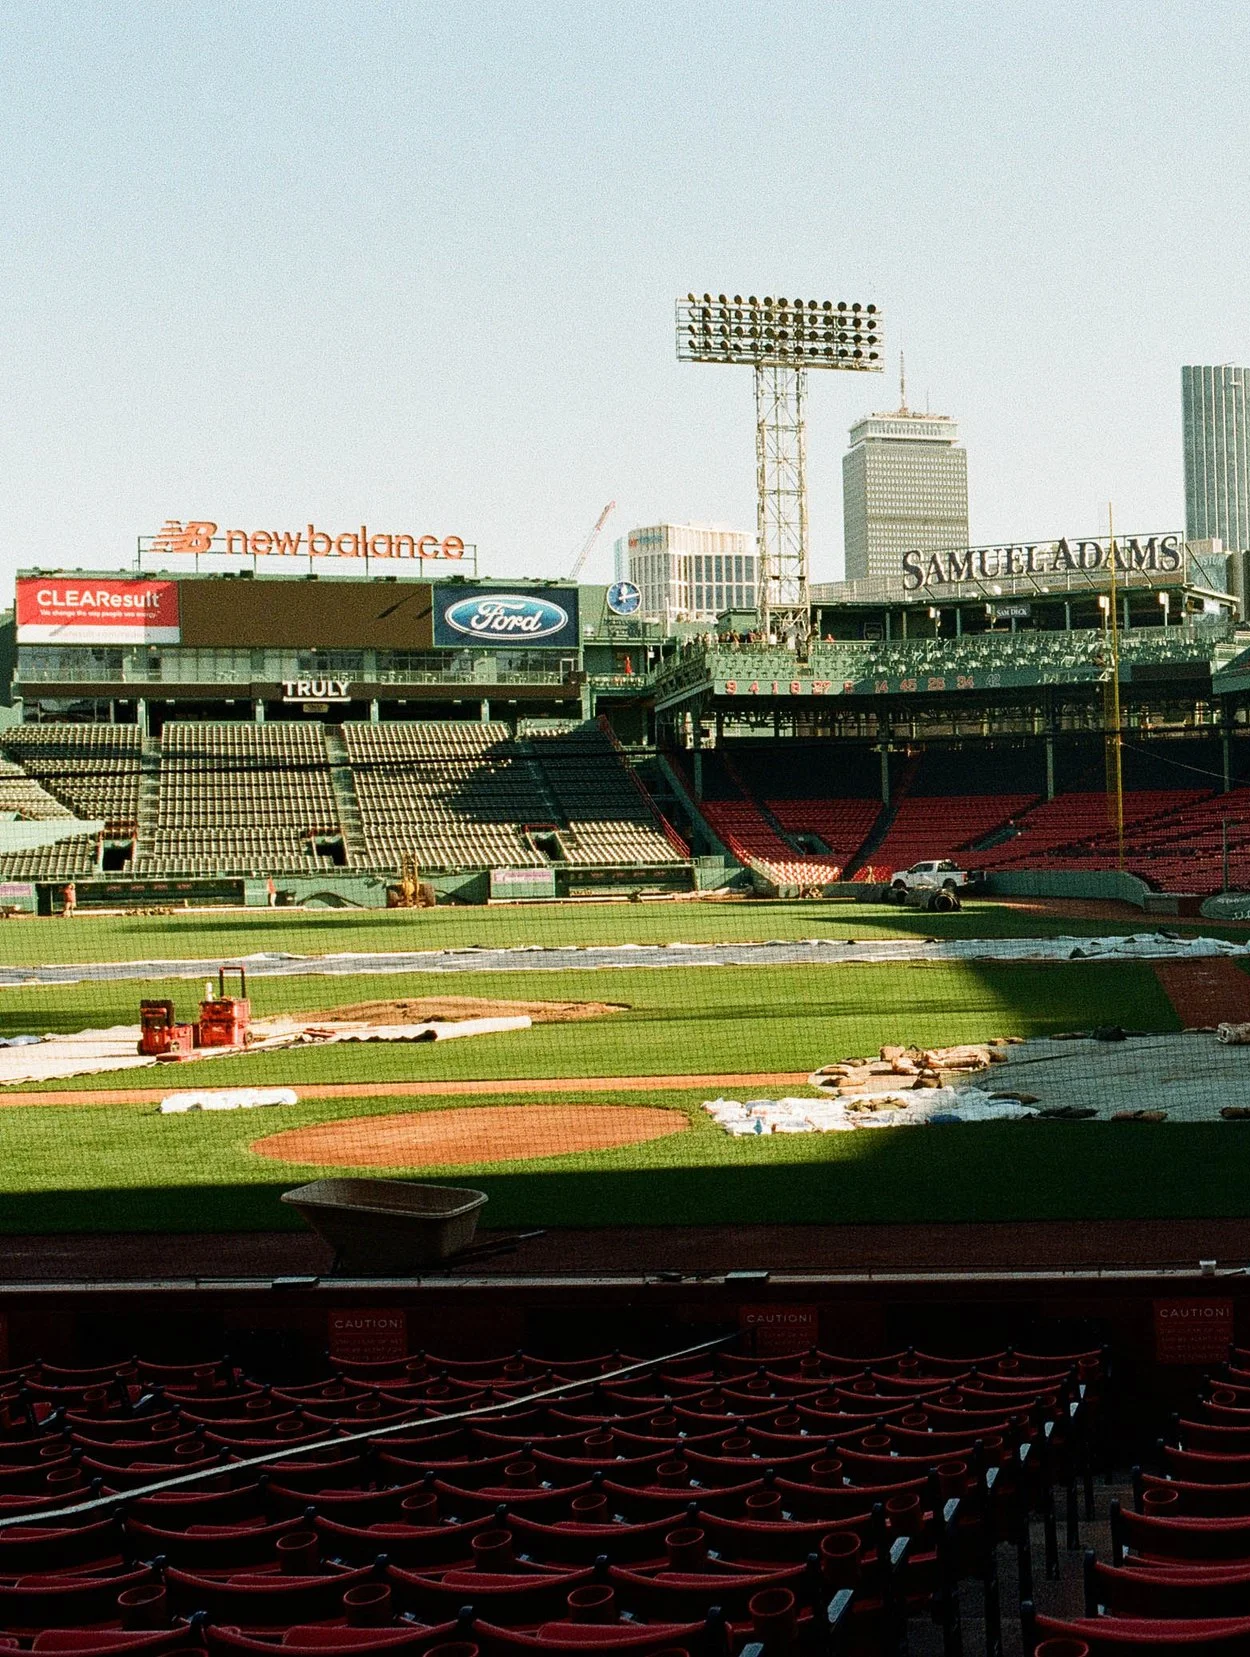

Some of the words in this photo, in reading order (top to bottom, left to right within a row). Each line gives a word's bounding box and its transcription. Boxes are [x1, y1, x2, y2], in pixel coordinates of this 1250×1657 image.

[902, 545, 1045, 590] SAMUEL
[1053, 536, 1181, 572] ADAMS
[37, 589, 160, 608] CLEAResult
[471, 600, 544, 632] Ford
[282, 680, 350, 697] TRULY
[726, 680, 737, 694] 9
[748, 680, 759, 694] 4
[772, 680, 779, 694] 1
[812, 680, 831, 694] 27
[875, 680, 889, 694] 14
[900, 678, 918, 692] 45
[956, 676, 975, 689] 34
[746, 1313, 812, 1323] CAUTION!
[1160, 1307, 1230, 1318] CAUTION!
[334, 1319, 403, 1329] CAUTION!
